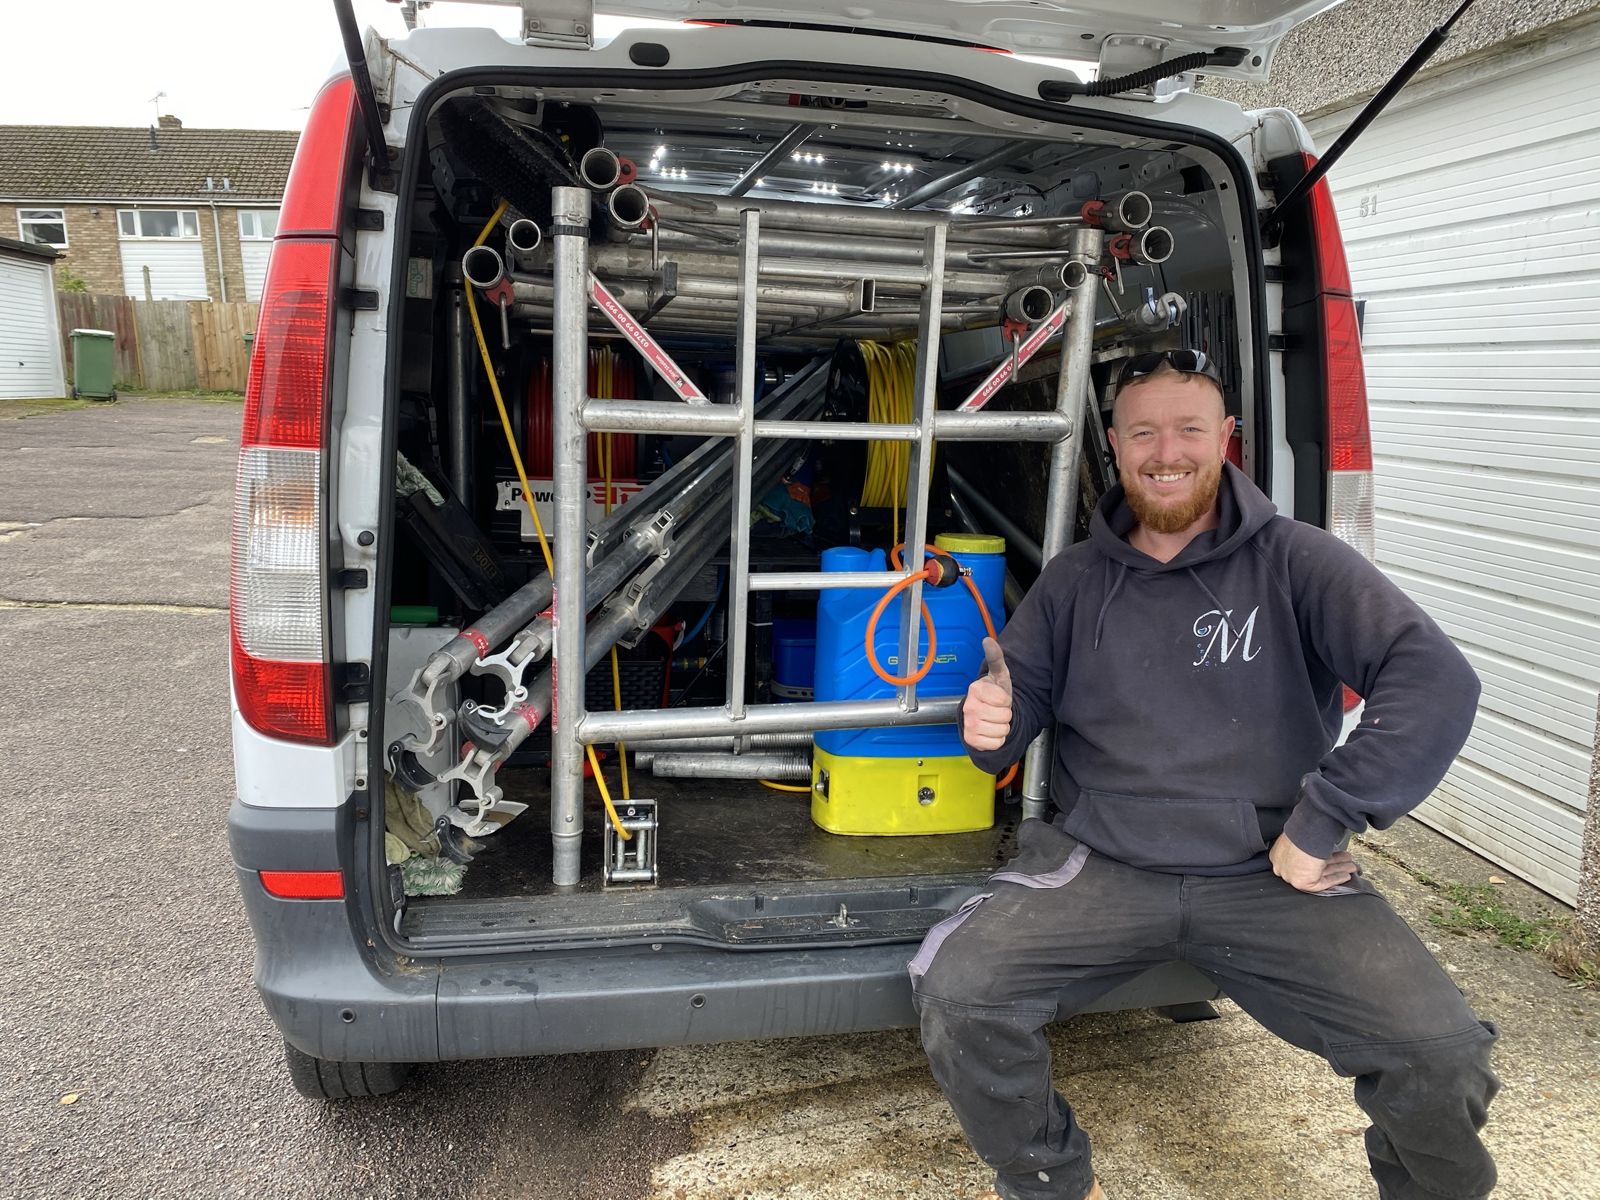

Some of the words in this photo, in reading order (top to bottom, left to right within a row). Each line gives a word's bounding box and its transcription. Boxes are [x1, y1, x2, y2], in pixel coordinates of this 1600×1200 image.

[1360, 195, 1377, 217] 51
[605, 301, 619, 315] 999
[617, 313, 627, 323] 00
[625, 322, 635, 332] 99
[633, 331, 649, 348] 0370
[992, 377, 1001, 386] 00
[1000, 370, 1008, 379] 99
[982, 382, 994, 396] 999
[1193, 606, 1262, 666] M
